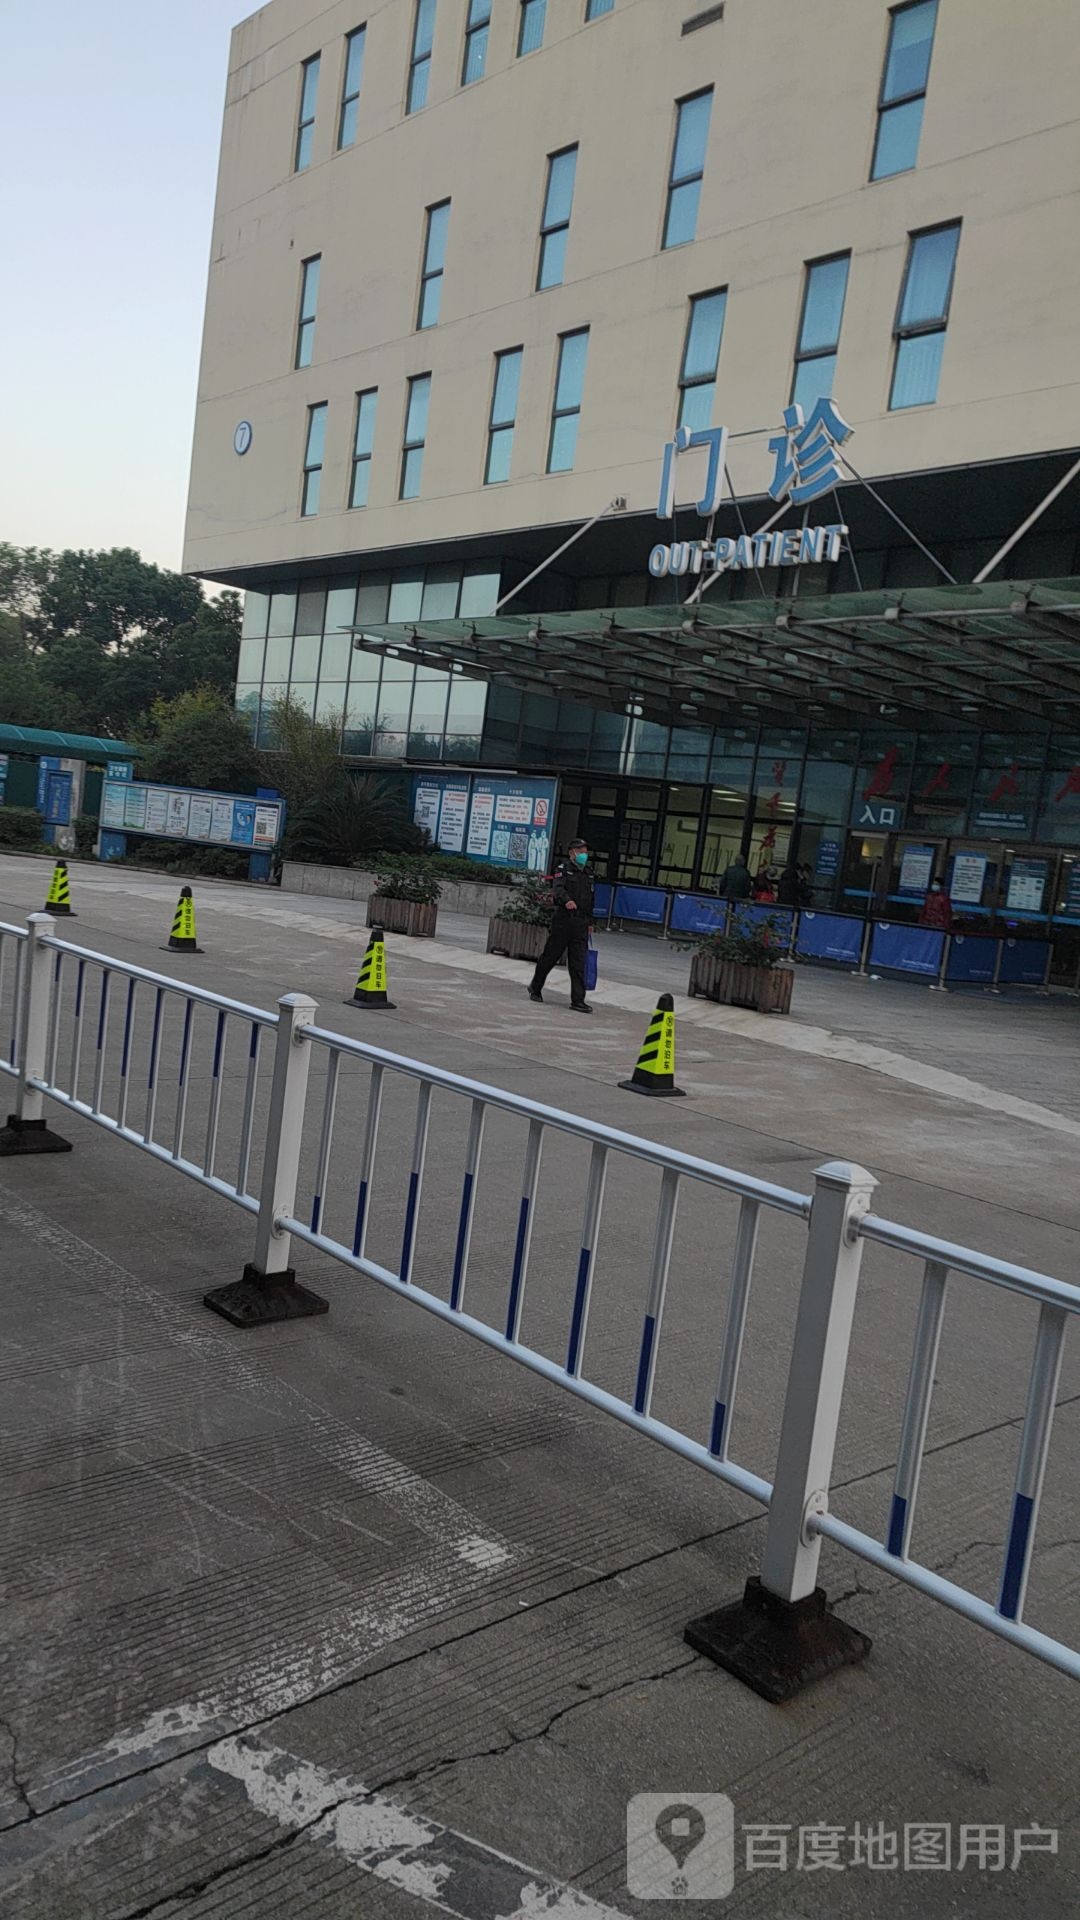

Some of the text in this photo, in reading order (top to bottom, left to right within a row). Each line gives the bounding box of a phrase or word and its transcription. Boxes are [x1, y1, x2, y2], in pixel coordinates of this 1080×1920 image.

[656, 397, 855, 519] 门诊
[649, 524, 849, 578] OUT-PATIENT
[859, 804, 896, 826] 入口
